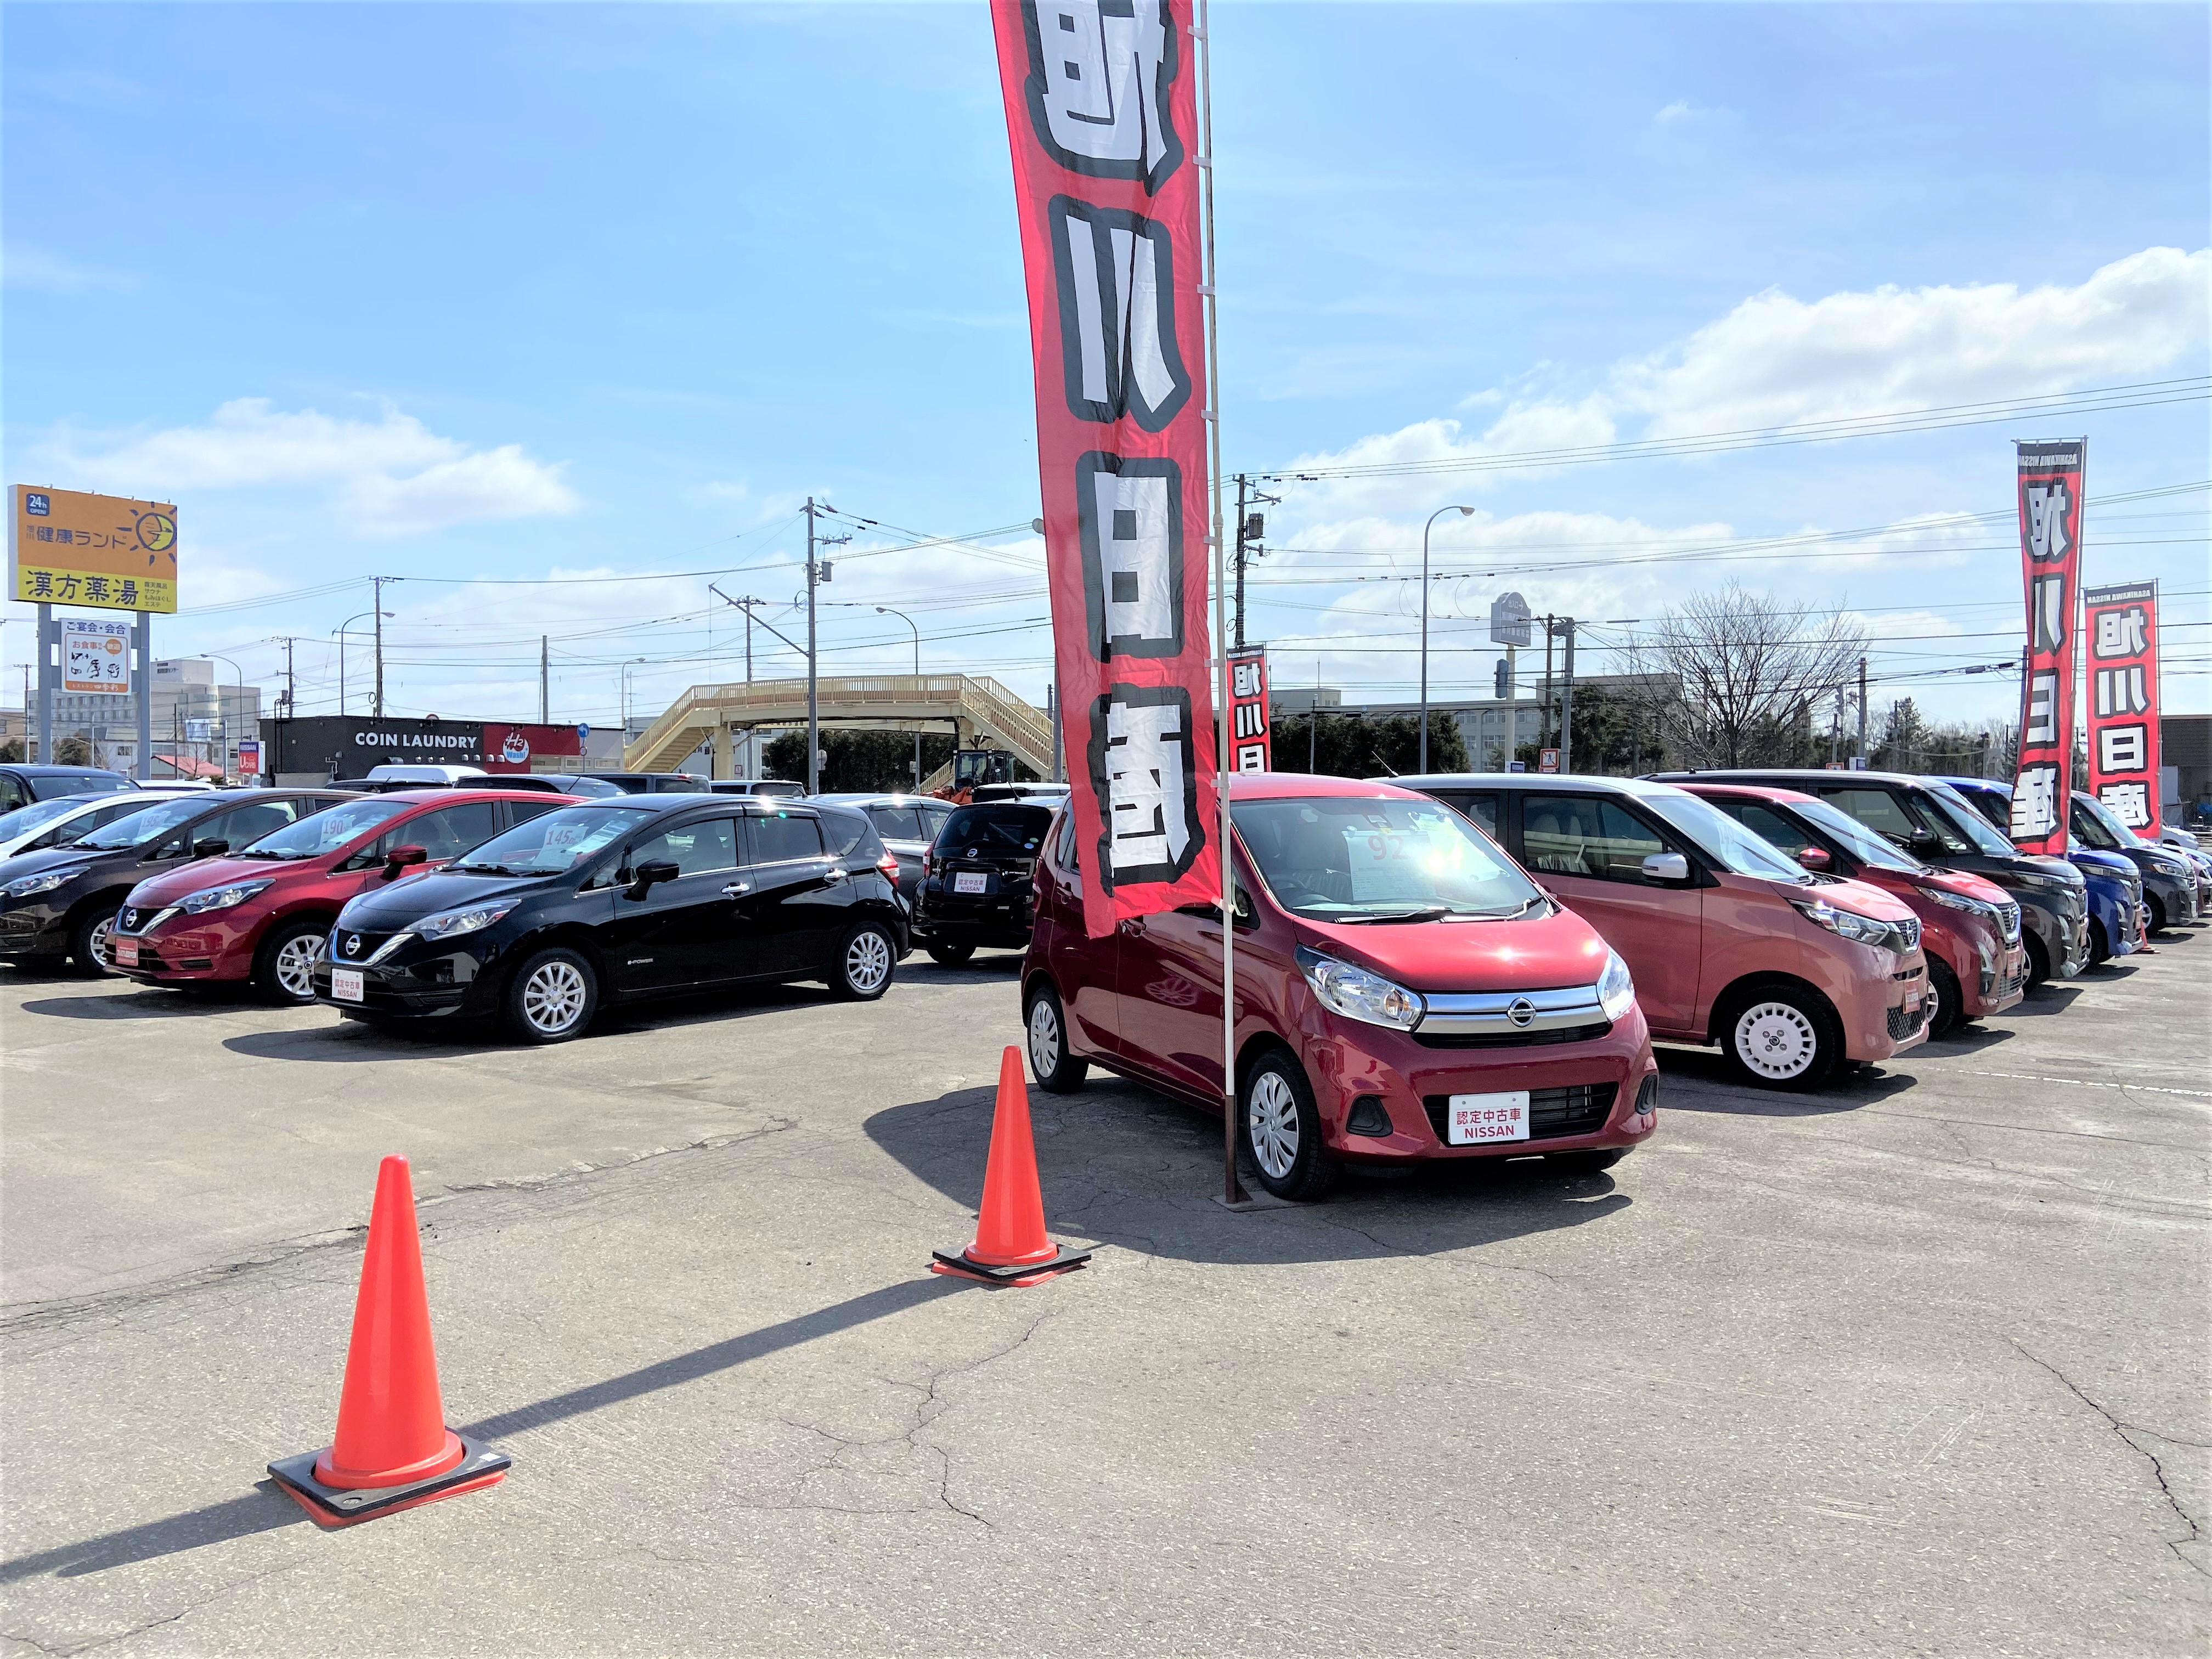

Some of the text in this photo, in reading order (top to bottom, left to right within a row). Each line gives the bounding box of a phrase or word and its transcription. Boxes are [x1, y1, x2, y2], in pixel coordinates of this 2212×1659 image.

[29, 495, 47, 509] 24h
[26, 570, 139, 606] 漢方薬湯
[67, 622, 126, 635] ご宴会・会合
[355, 732, 477, 749] COIN LAUNDRY
[337, 989, 357, 998] NISSAN
[1457, 1108, 1521, 1125] 認定中古車
[1465, 1125, 1515, 1139] NISSAN
